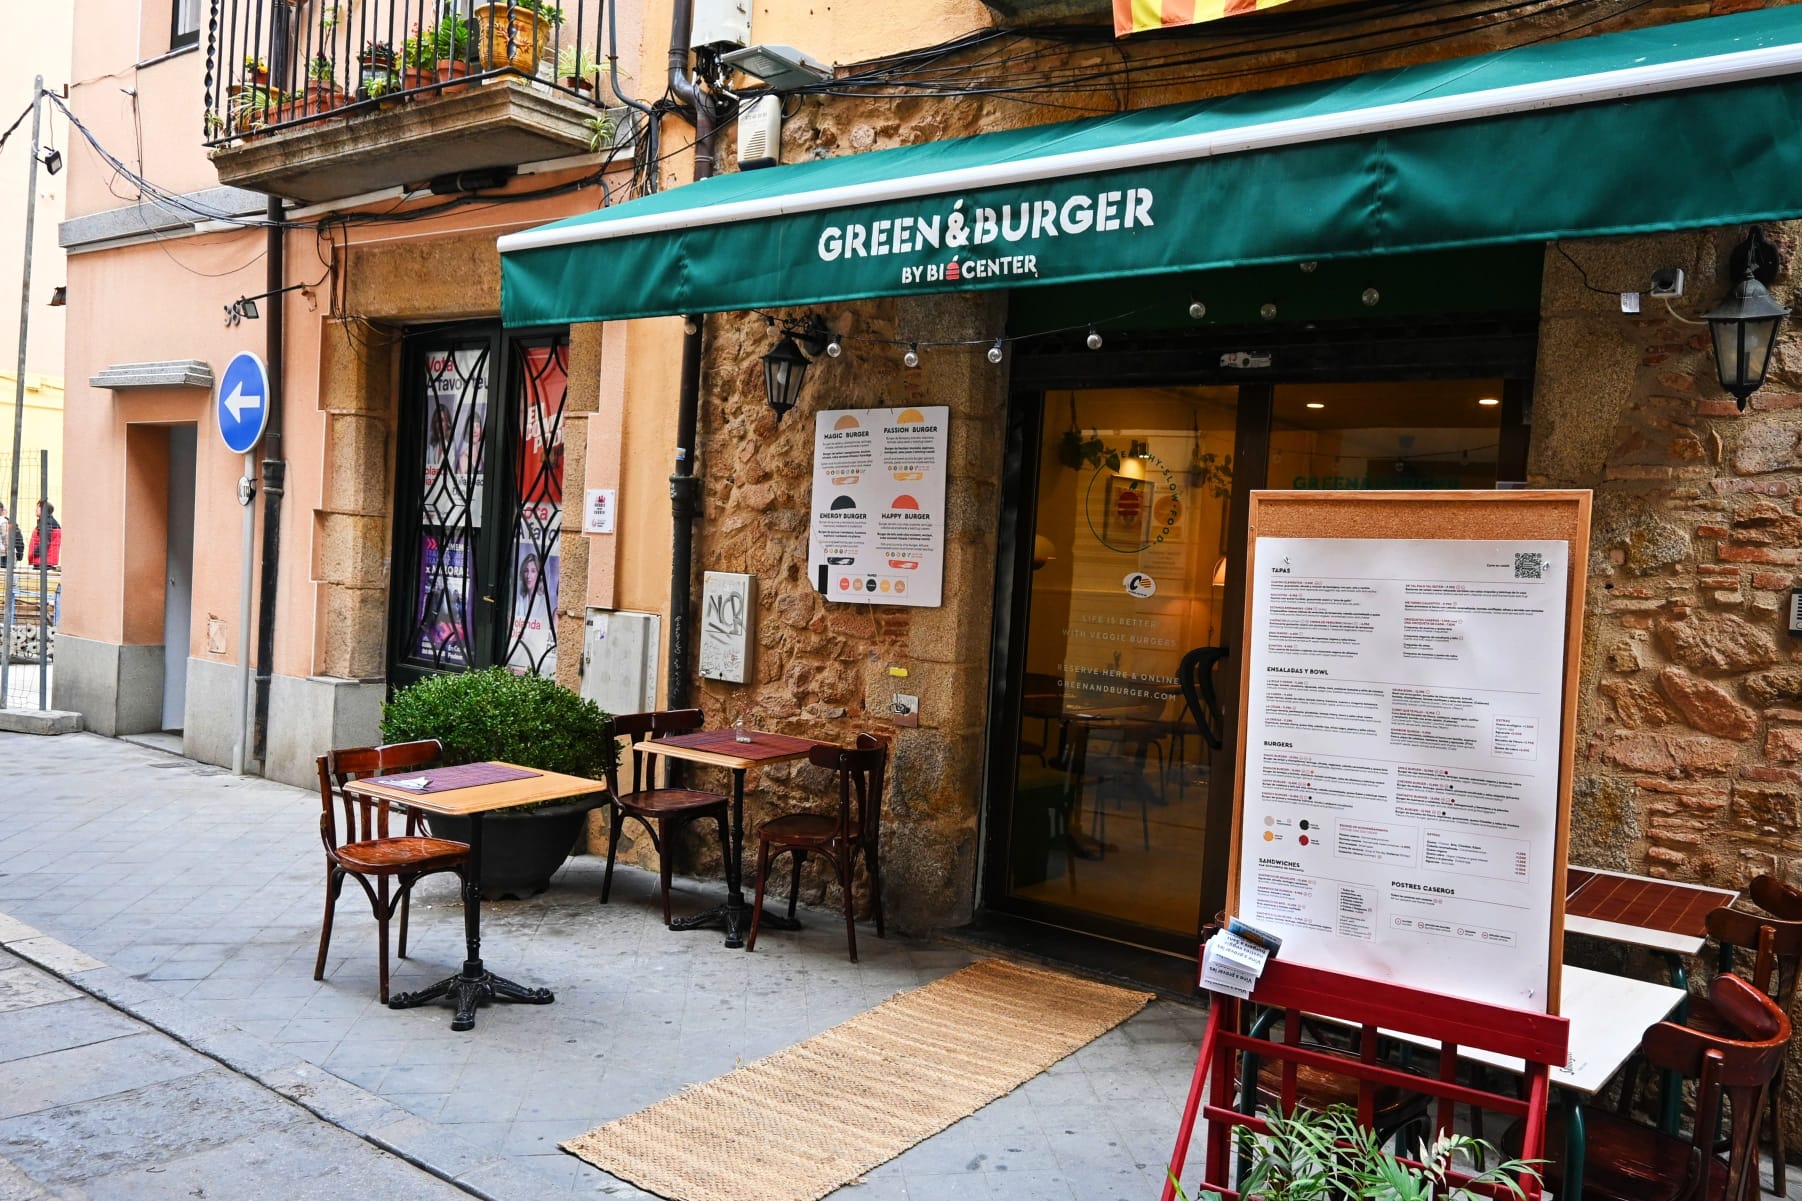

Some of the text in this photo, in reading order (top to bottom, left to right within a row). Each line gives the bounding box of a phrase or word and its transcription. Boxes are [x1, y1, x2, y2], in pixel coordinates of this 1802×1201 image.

[902, 265, 924, 284] BY
[846, 430, 869, 438] BURGER
[1082, 615, 1156, 628] LIFE IS BETTER
[1062, 628, 1177, 647] WITH VEGGIE BURGERS
[1057, 663, 1099, 675] RESERVE
[1103, 668, 1128, 679] HERE
[1141, 674, 1180, 685] ONLINE
[1267, 667, 1303, 675] ENSALADAS
[1057, 680, 1177, 702] GREENANDBURGER.COM
[1264, 741, 1293, 749] BURGERS
[1259, 858, 1301, 869] SANDWICHES
[1392, 881, 1455, 895] POSTRES CASEROS
